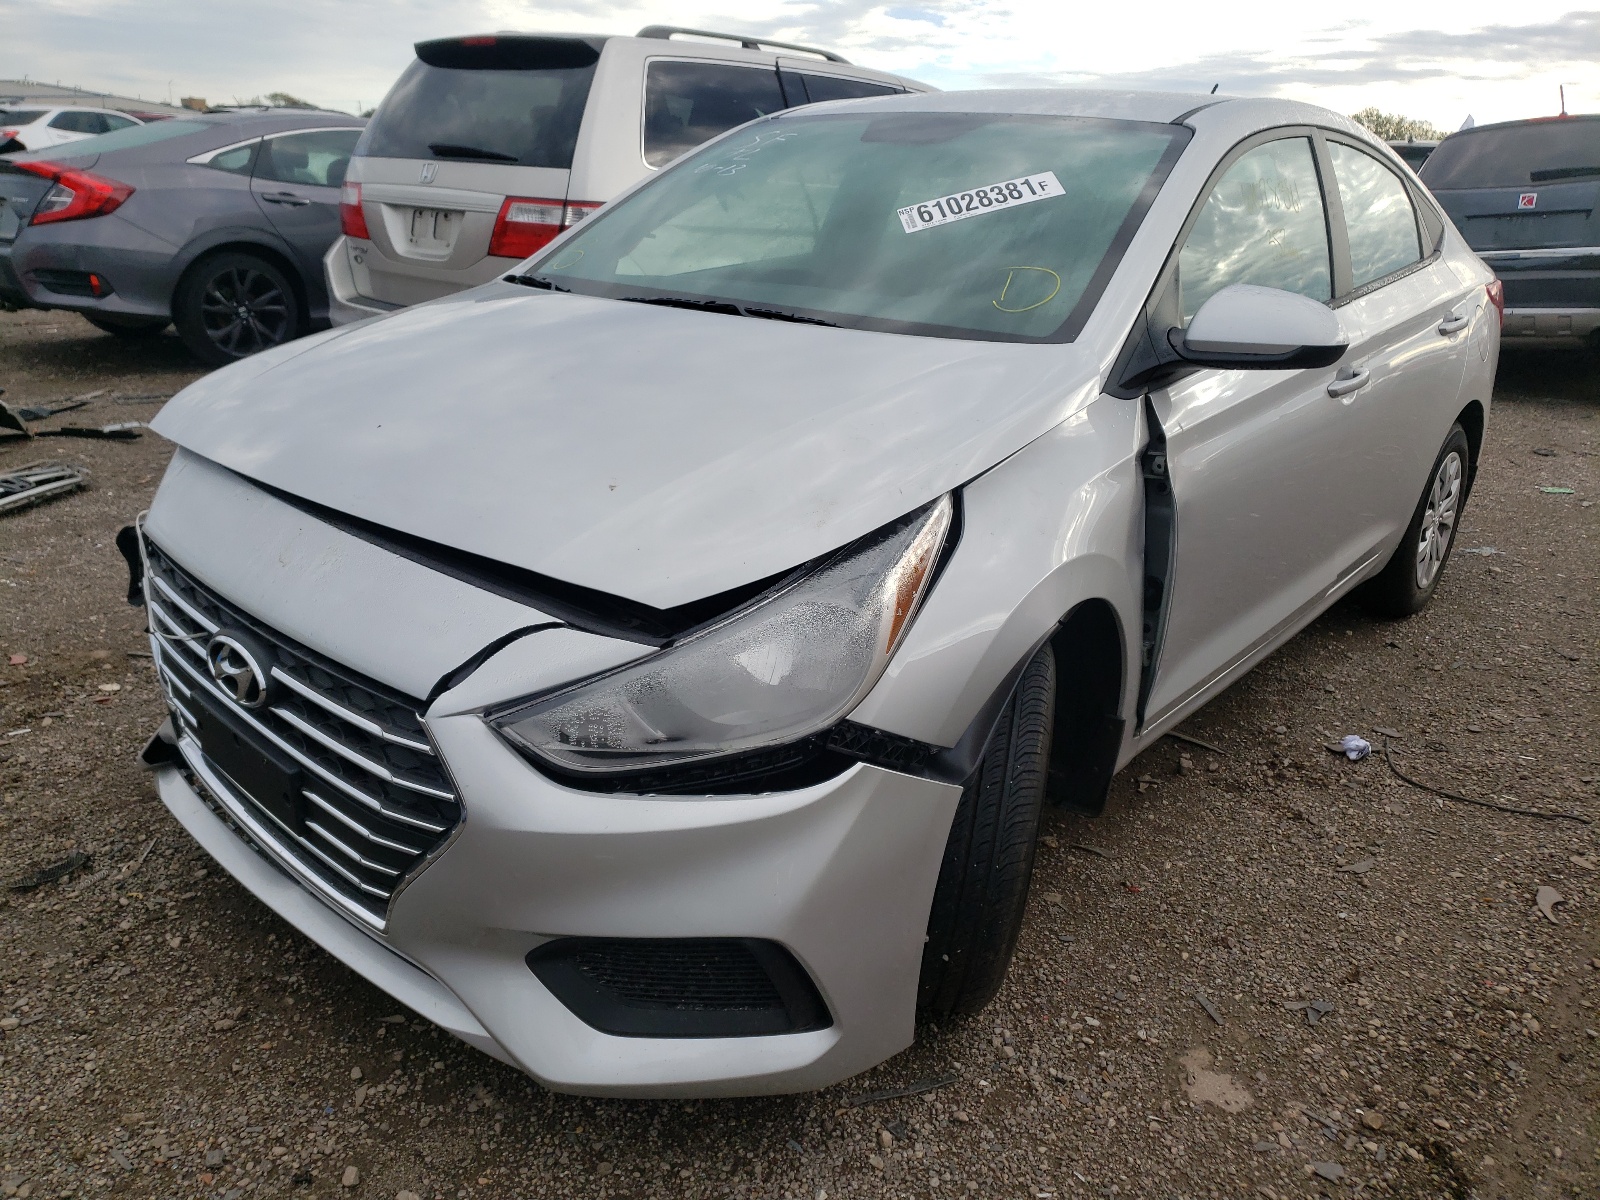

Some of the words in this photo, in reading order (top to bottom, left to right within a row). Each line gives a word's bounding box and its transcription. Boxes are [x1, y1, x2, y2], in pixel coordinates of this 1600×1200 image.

[898, 206, 915, 216] NSP
[916, 178, 1037, 223] 61028381
[1038, 181, 1048, 192] F
